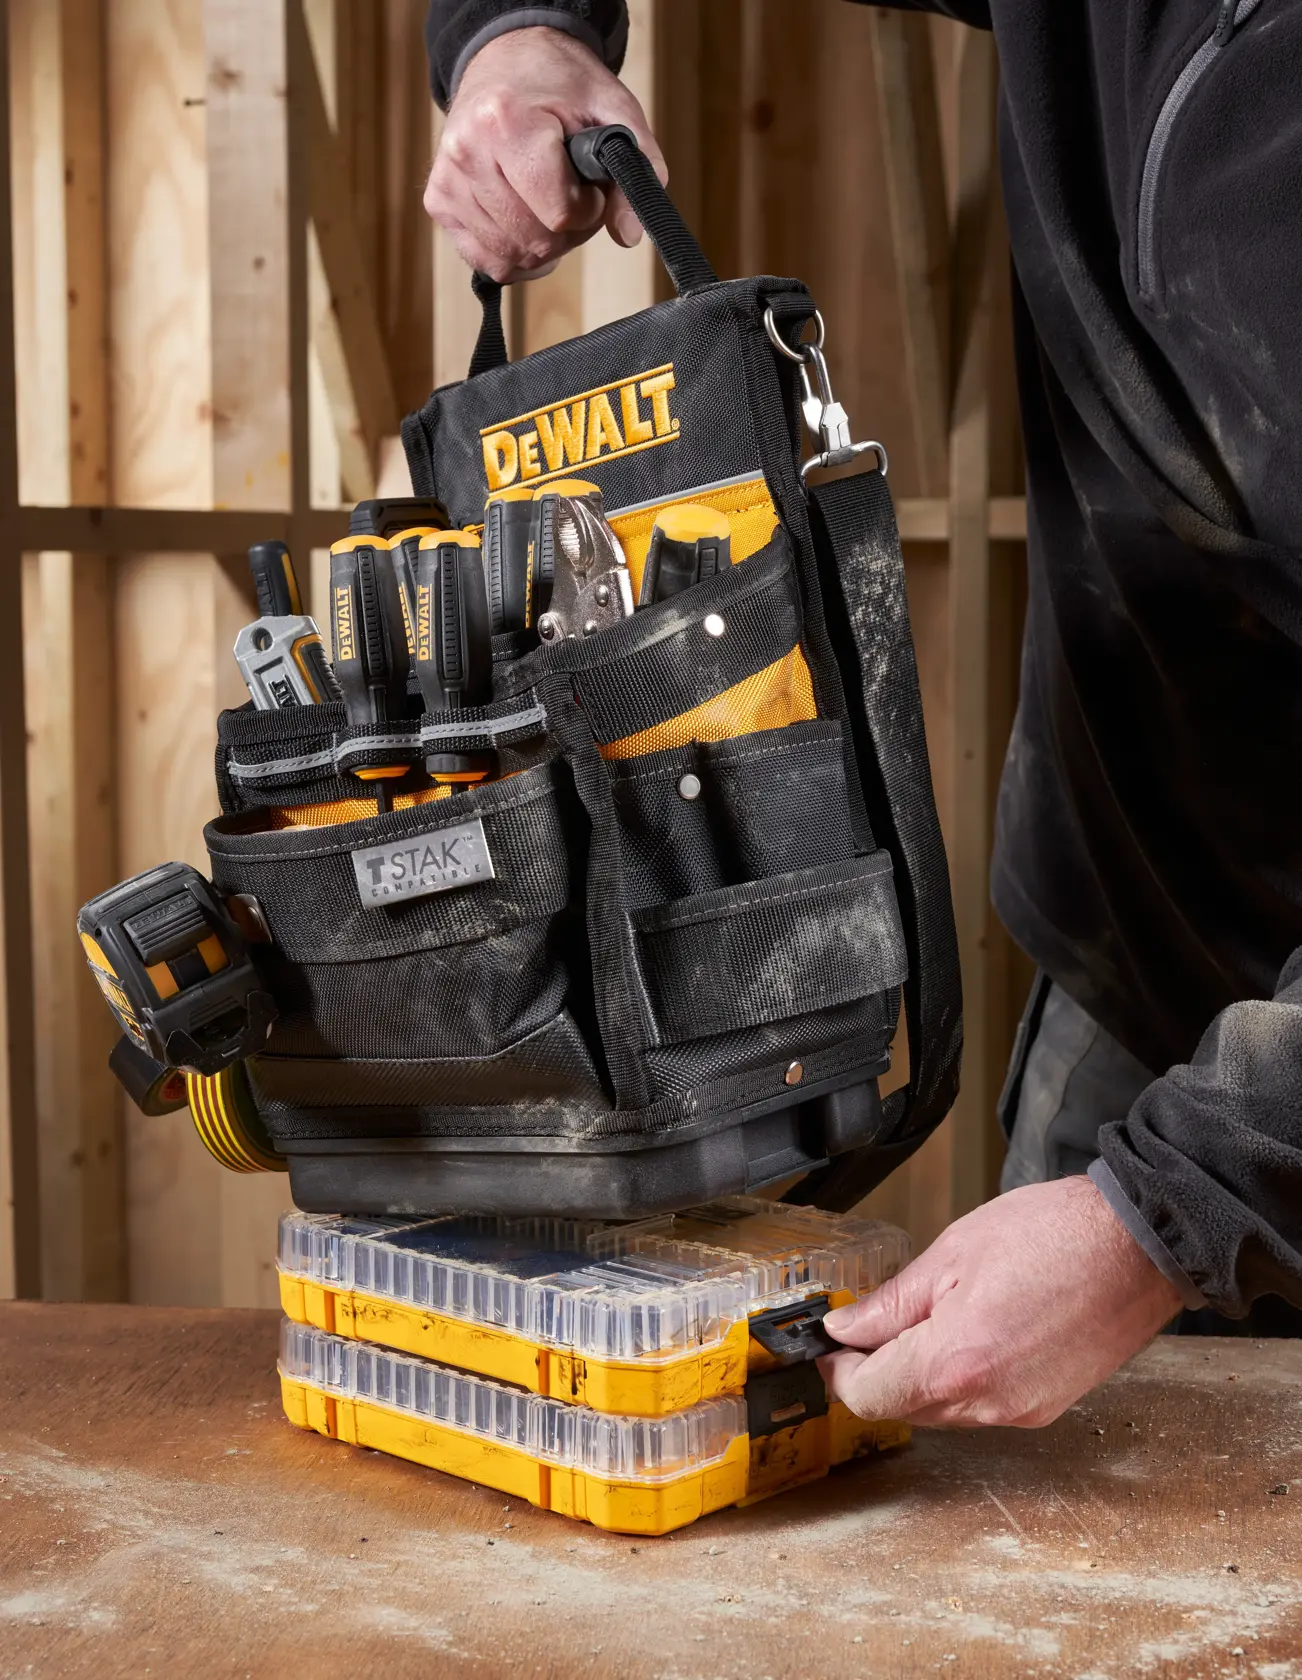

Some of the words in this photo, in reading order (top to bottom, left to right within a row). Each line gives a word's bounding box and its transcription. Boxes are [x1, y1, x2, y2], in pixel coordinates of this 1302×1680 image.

[336, 586, 353, 661] DEWALT
[418, 585, 430, 660] DEWALT
[372, 864, 481, 898] COMPATIBLE
